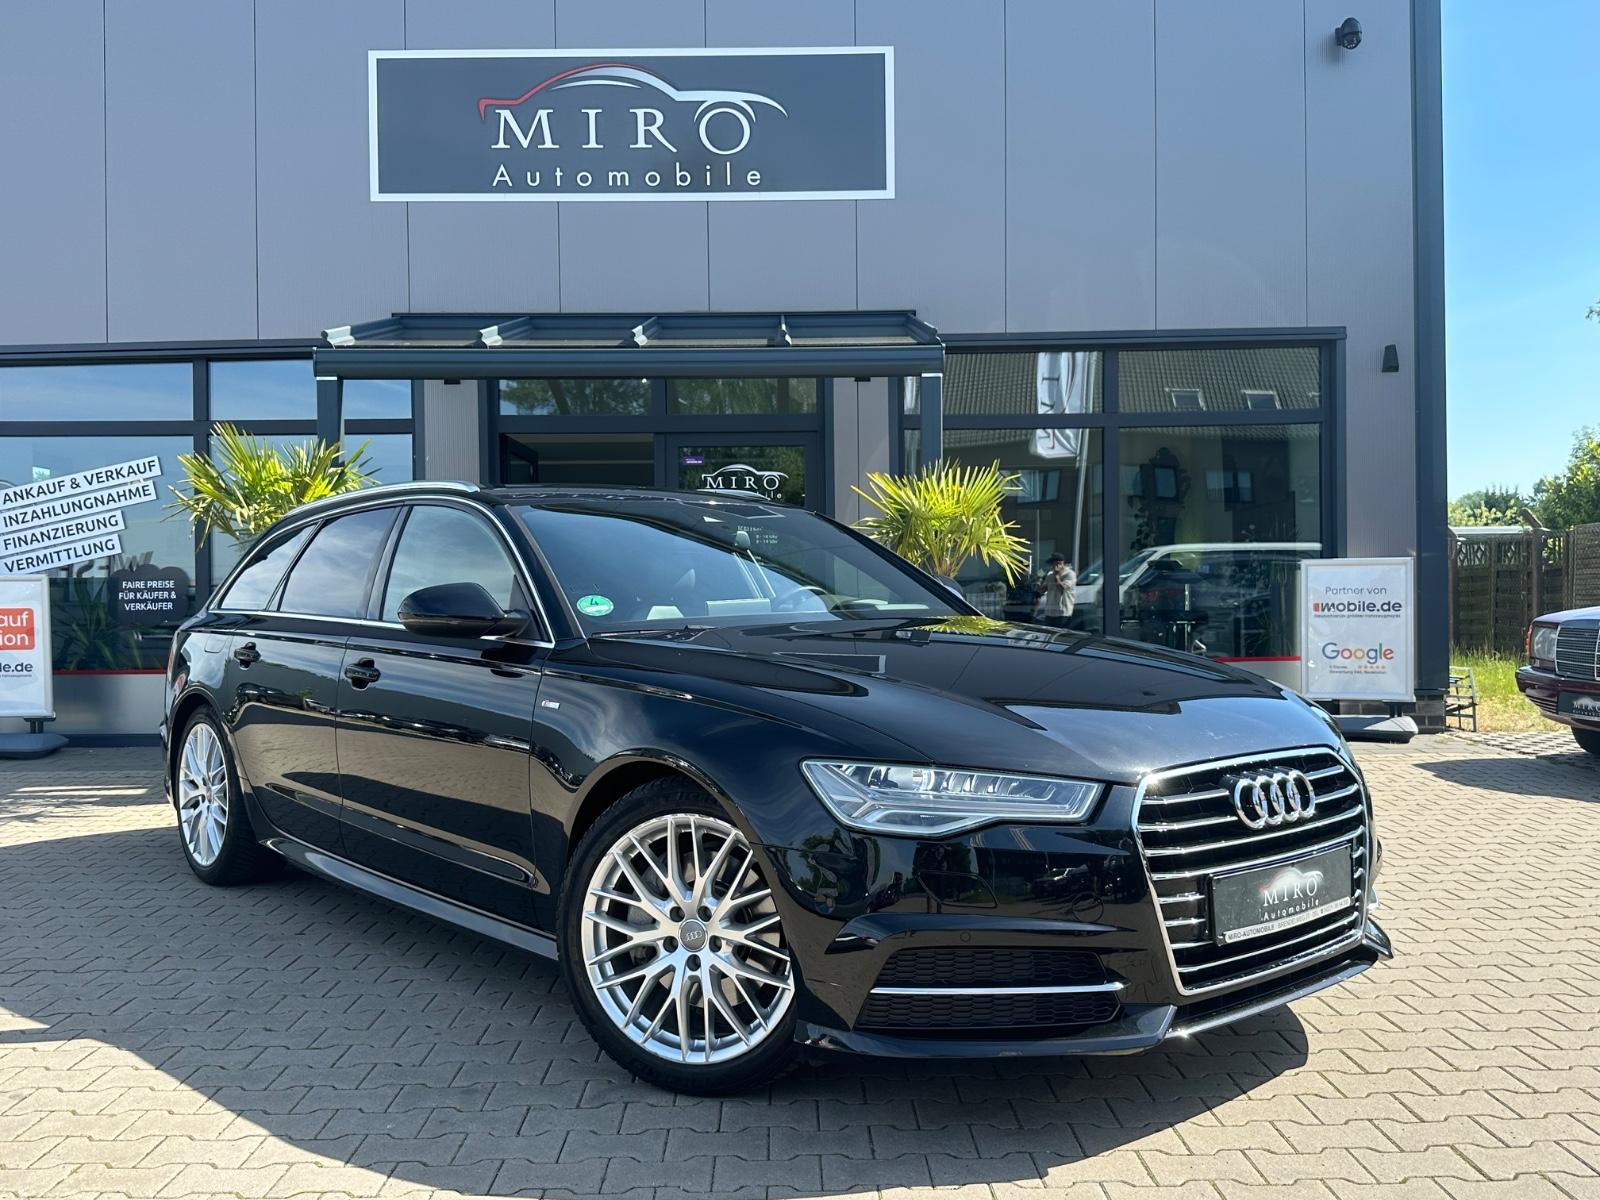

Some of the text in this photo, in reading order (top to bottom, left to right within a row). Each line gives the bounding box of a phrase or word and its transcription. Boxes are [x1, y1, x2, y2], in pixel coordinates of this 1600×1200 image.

[491, 107, 751, 154] MIRO
[492, 162, 761, 187] Automobile
[2, 459, 157, 505] ANKAUF & VERKAUF
[705, 476, 779, 490] MIRO
[3, 485, 152, 528] INZAHLUNGNAHME
[4, 515, 119, 550] FINANZIERUNG
[5, 539, 116, 573] VERMITTLUNG
[118, 590, 177, 600] FÜR KÄUFER &
[122, 580, 175, 589] FAIRE PREISE
[1325, 586, 1387, 595] Partner von
[124, 601, 173, 611] VERKÄUFER
[1320, 600, 1402, 612] mobile.de
[1322, 642, 1394, 665] Google
[1263, 879, 1318, 907] MIRO
[1263, 898, 1319, 922] Automobile
